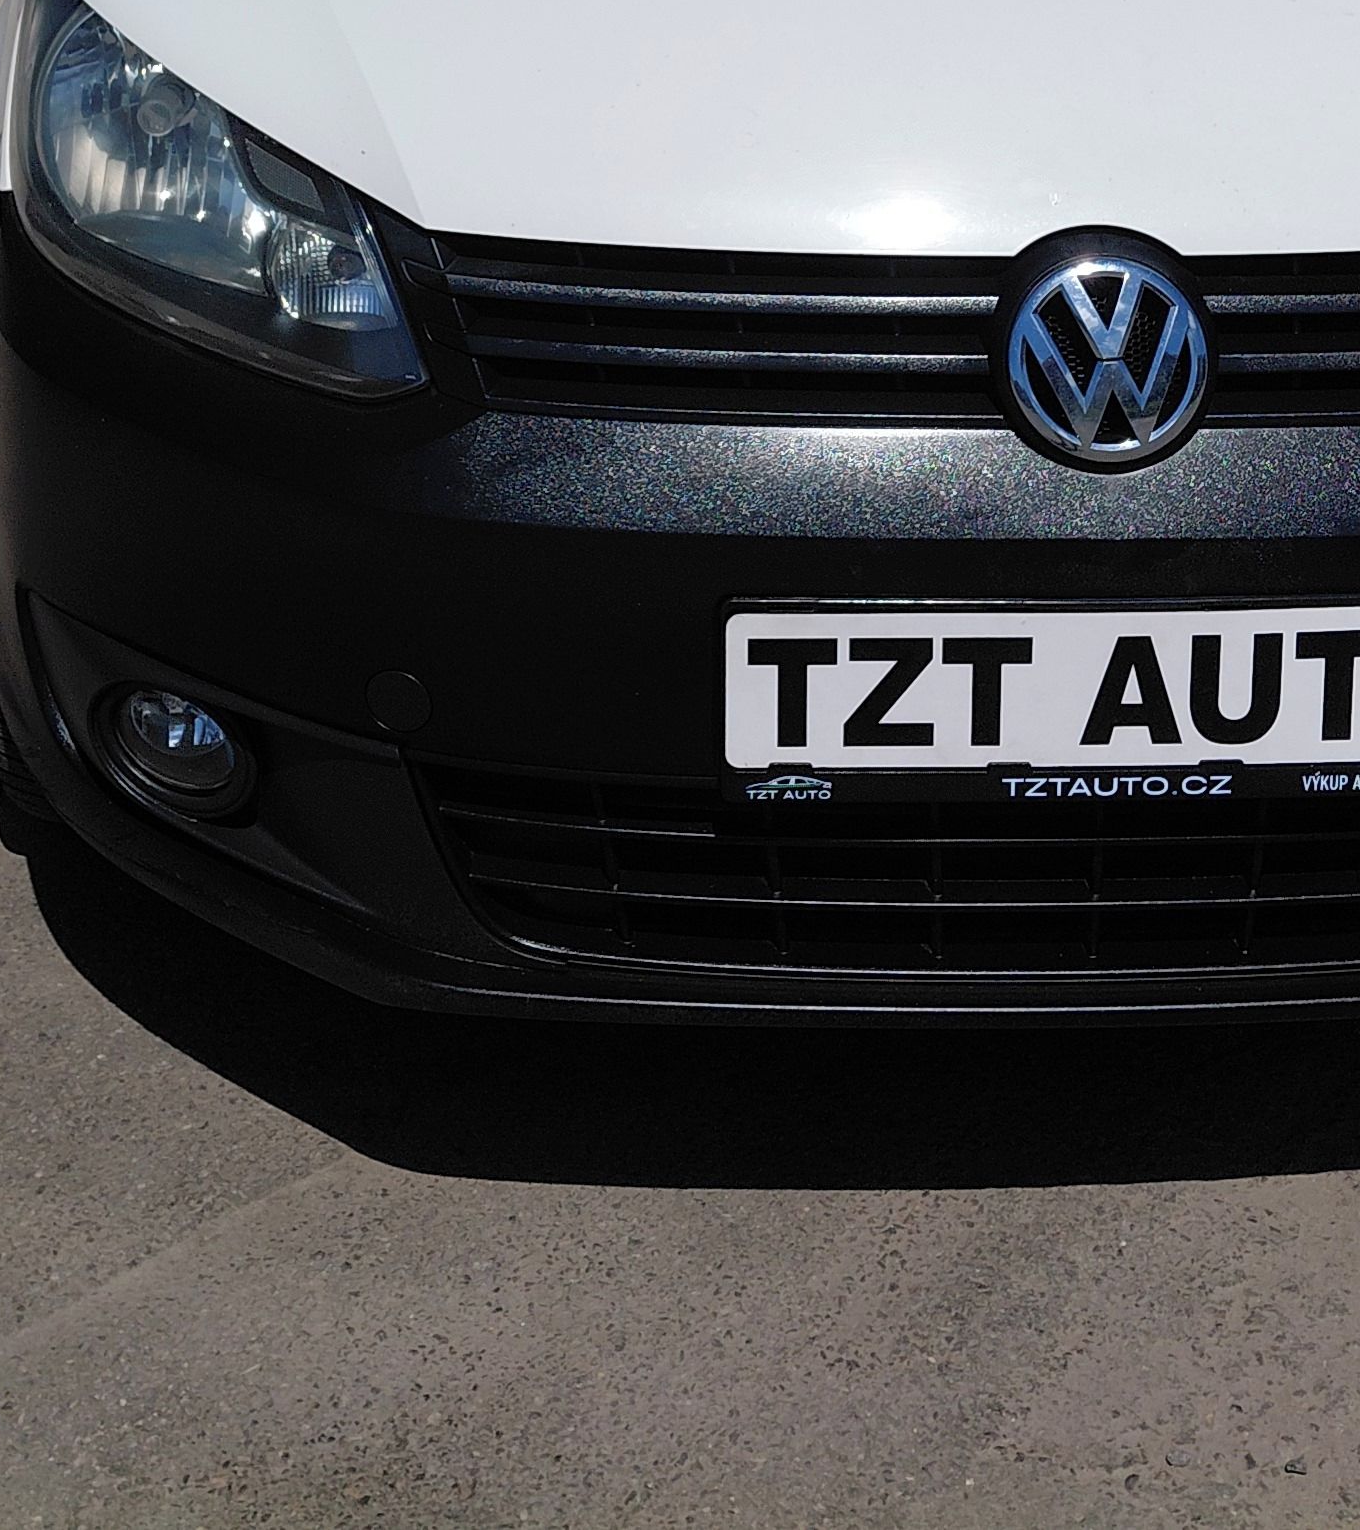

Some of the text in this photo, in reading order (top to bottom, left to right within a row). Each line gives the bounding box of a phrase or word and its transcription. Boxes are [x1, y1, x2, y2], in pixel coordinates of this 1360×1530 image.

[1013, 261, 1204, 457] VW
[746, 635, 1034, 748] TZT
[1001, 774, 1233, 798] TZTAUTO.CZ
[1302, 771, 1348, 791] VÝKUP
[746, 789, 832, 800] TZT AUTO
